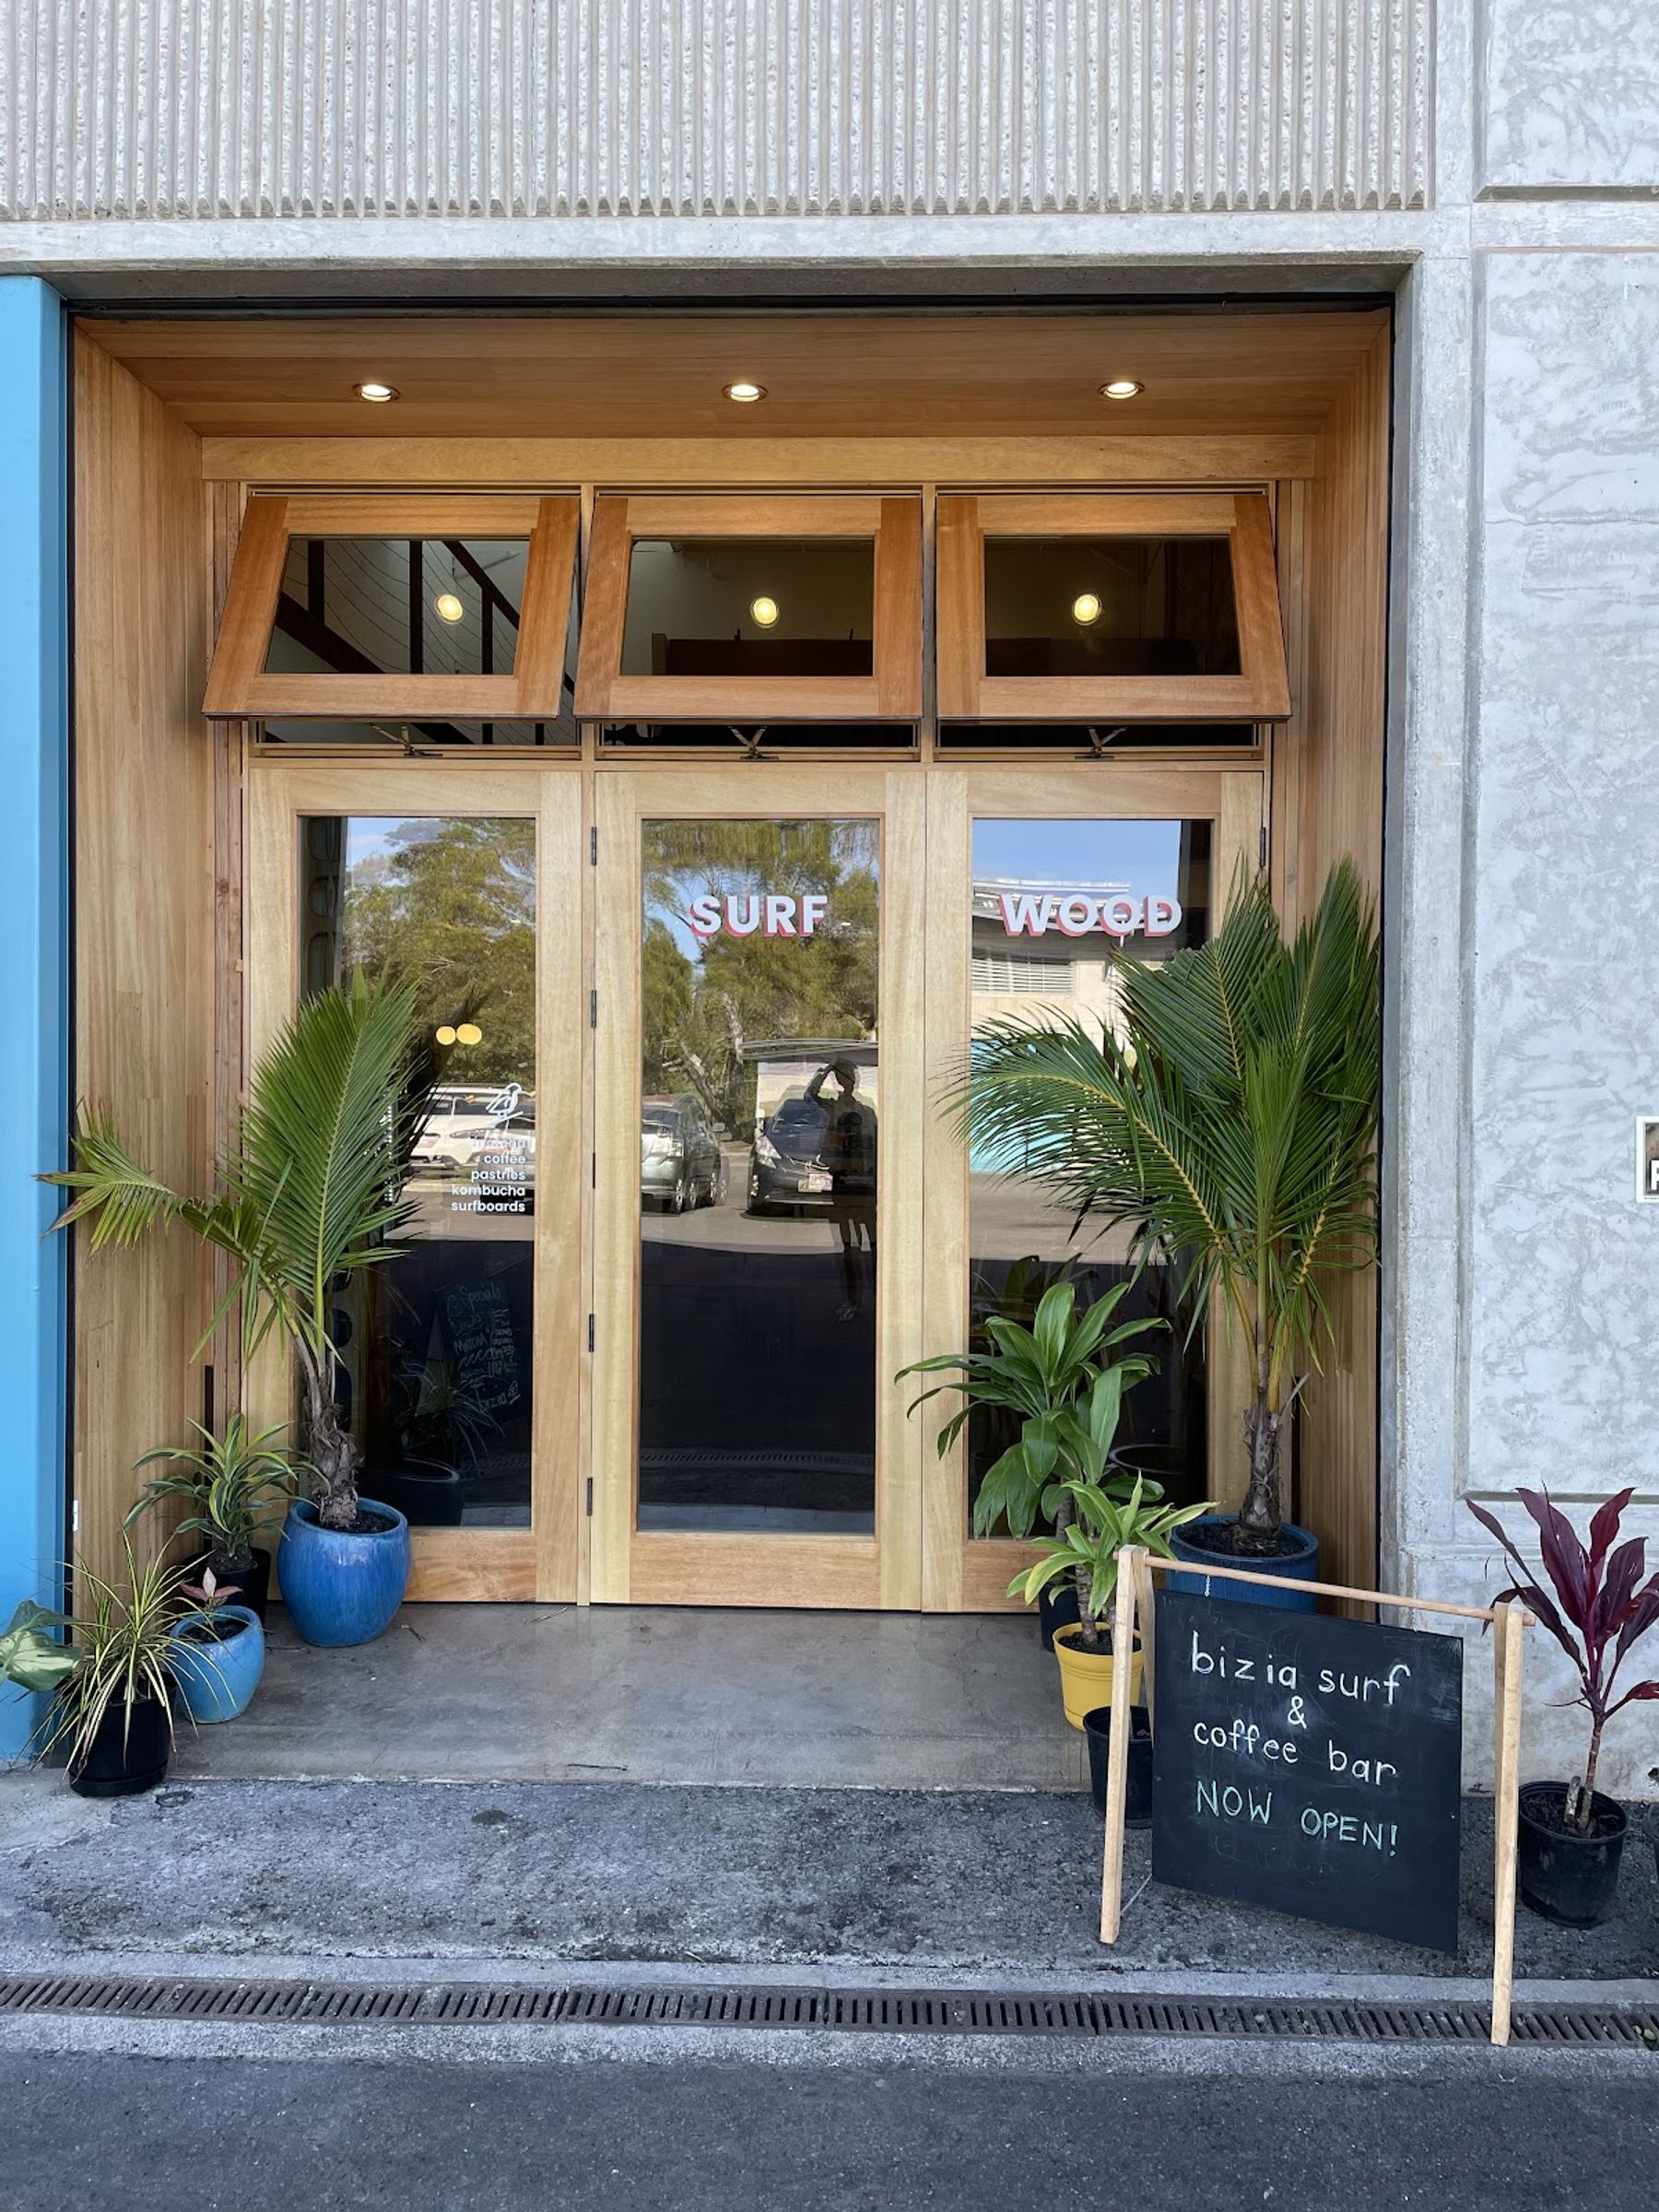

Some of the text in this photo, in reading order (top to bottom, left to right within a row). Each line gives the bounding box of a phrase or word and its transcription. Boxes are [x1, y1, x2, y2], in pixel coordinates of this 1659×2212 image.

[689, 894, 1182, 937] SURF WOOD
[484, 1152, 526, 1164] coffee
[452, 1184, 525, 1196] kombucha
[471, 1169, 525, 1182] pastries
[451, 1200, 525, 1212] surfboards
[1191, 1630, 1411, 1707] bizia surf
[1287, 1695, 1308, 1729] &
[1193, 1718, 1398, 1786] coffee bar
[1195, 1779, 1400, 1857] NOW OPEN!
